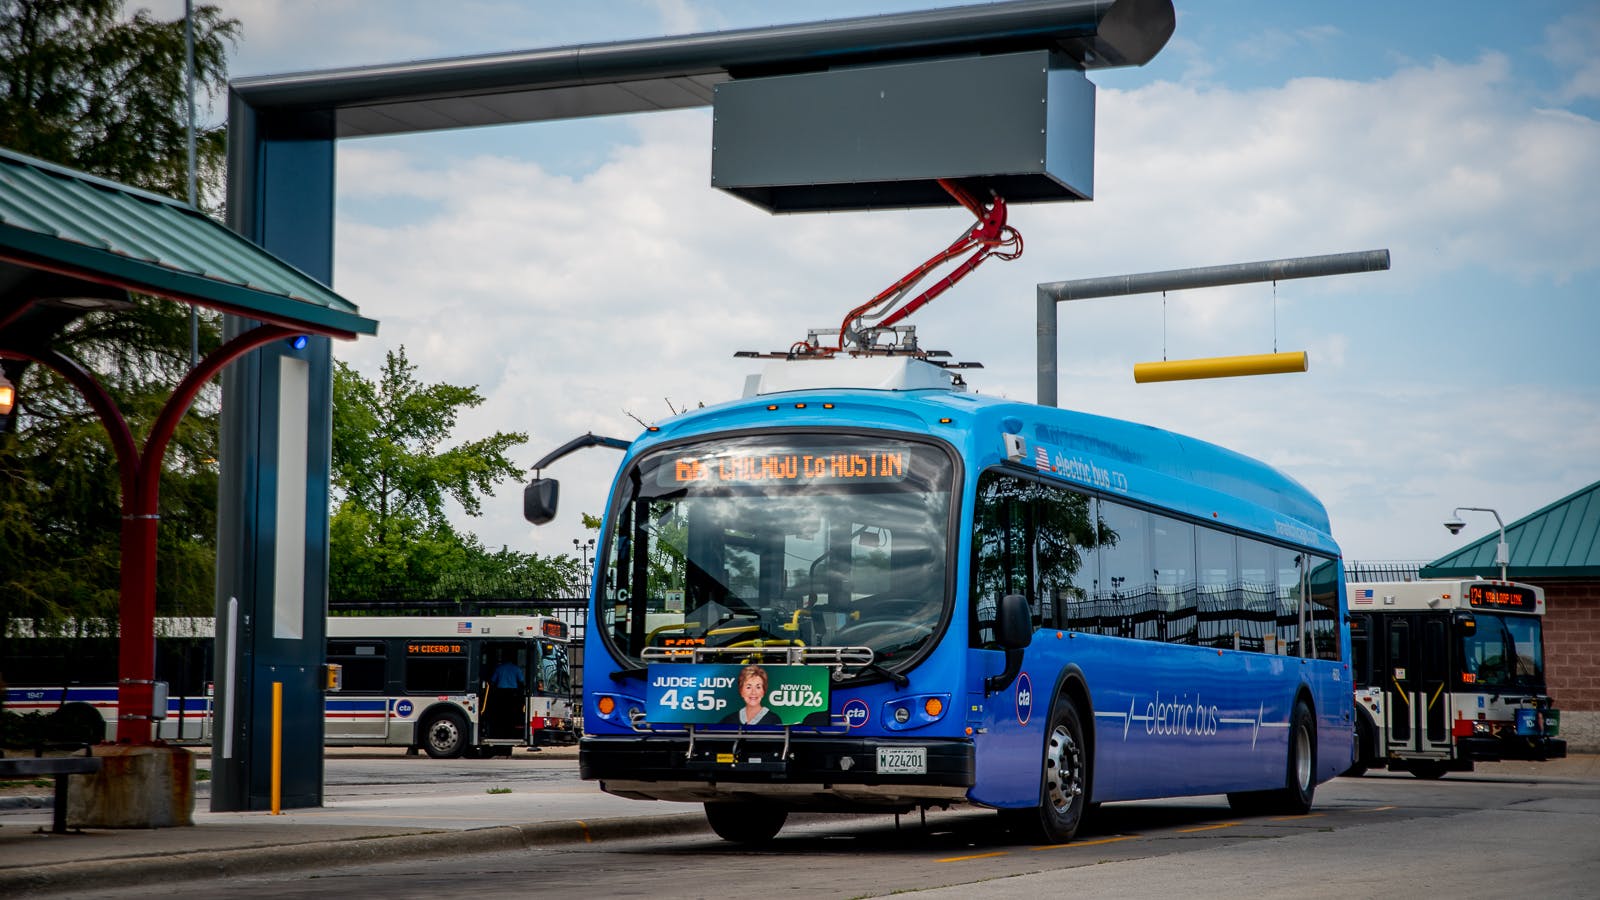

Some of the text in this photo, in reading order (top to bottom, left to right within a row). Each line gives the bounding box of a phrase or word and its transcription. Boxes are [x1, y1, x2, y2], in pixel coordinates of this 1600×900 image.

[1055, 451, 1111, 488] electric bus
[421, 645, 450, 653] CICERO
[652, 677, 735, 689] JUDGE JUDY
[1018, 689, 1030, 706] cta
[846, 708, 865, 718] cta
[1146, 690, 1218, 736] electric bus
[888, 754, 923, 768] 224201
